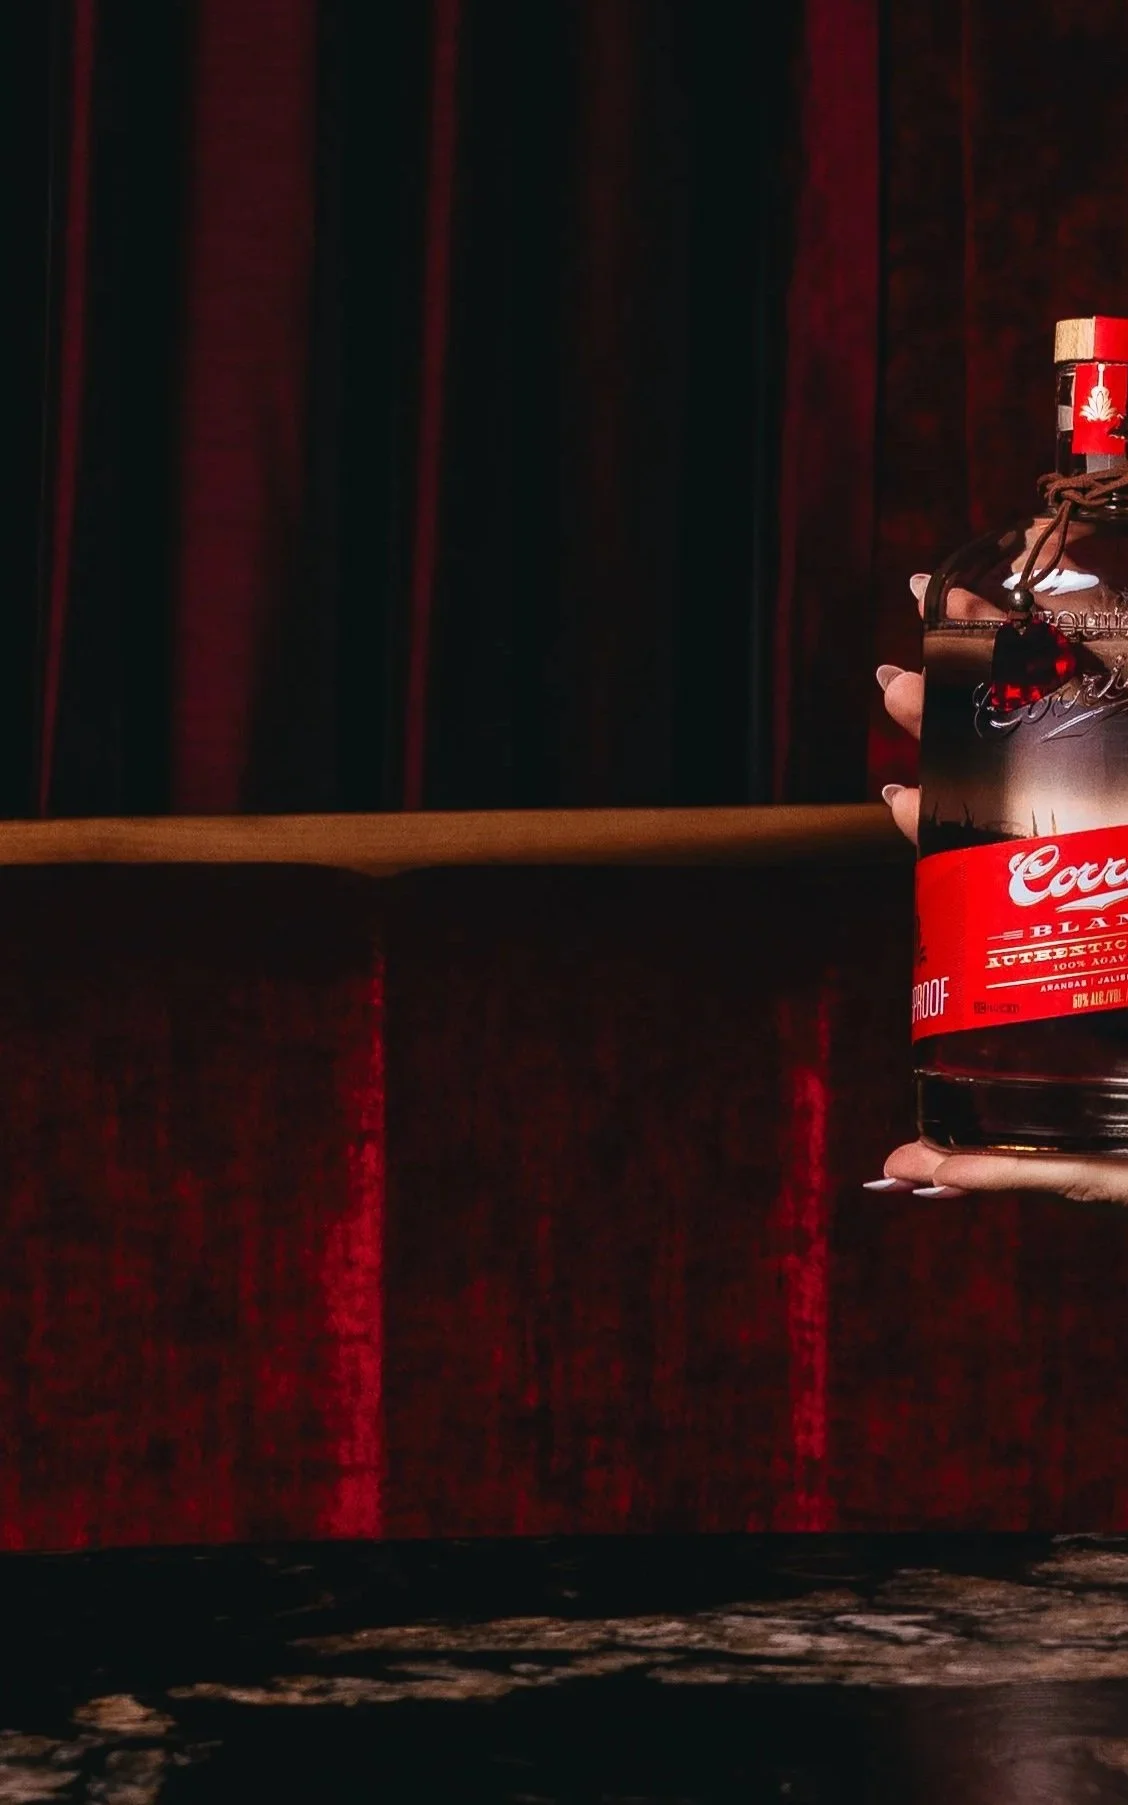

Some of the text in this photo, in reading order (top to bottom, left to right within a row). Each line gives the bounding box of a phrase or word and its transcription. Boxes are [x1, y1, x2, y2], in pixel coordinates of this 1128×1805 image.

[985, 939, 1128, 969] AUTHENTIC
[1053, 961, 1086, 972] 100%
[1040, 979, 1087, 993] ARANDAS
[912, 976, 950, 1024] PROOF
